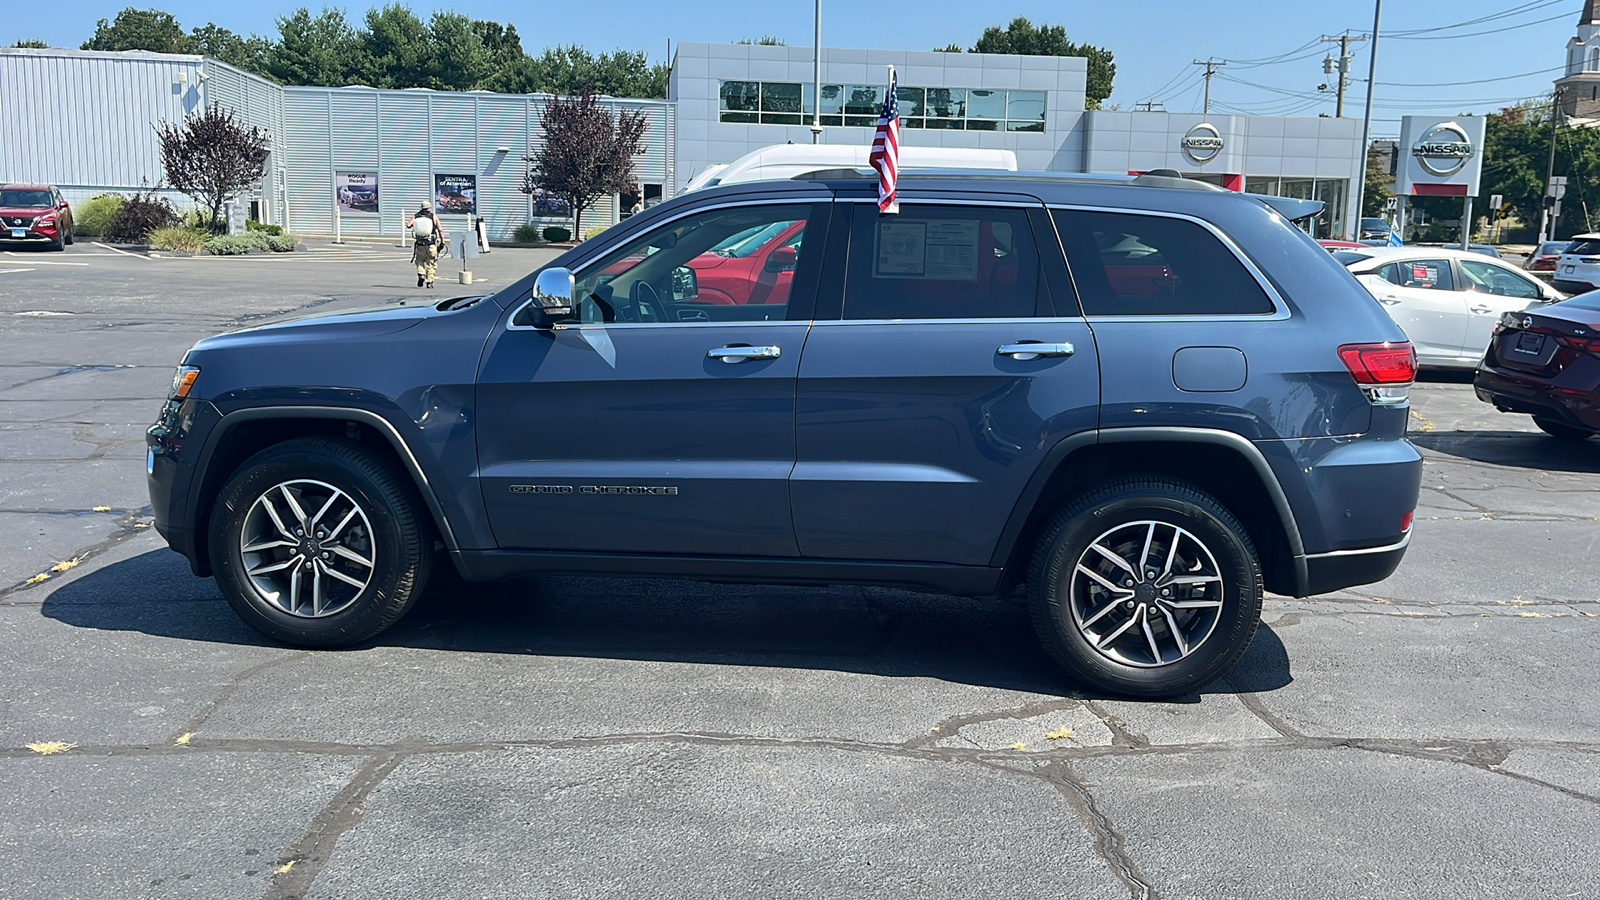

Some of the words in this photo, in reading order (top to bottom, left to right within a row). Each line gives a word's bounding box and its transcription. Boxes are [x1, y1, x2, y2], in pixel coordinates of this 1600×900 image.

[1185, 139, 1221, 147] NISSAN
[1420, 145, 1470, 154] NISSAN
[509, 485, 573, 494] GRAND
[579, 485, 678, 495] CHEROKEE
